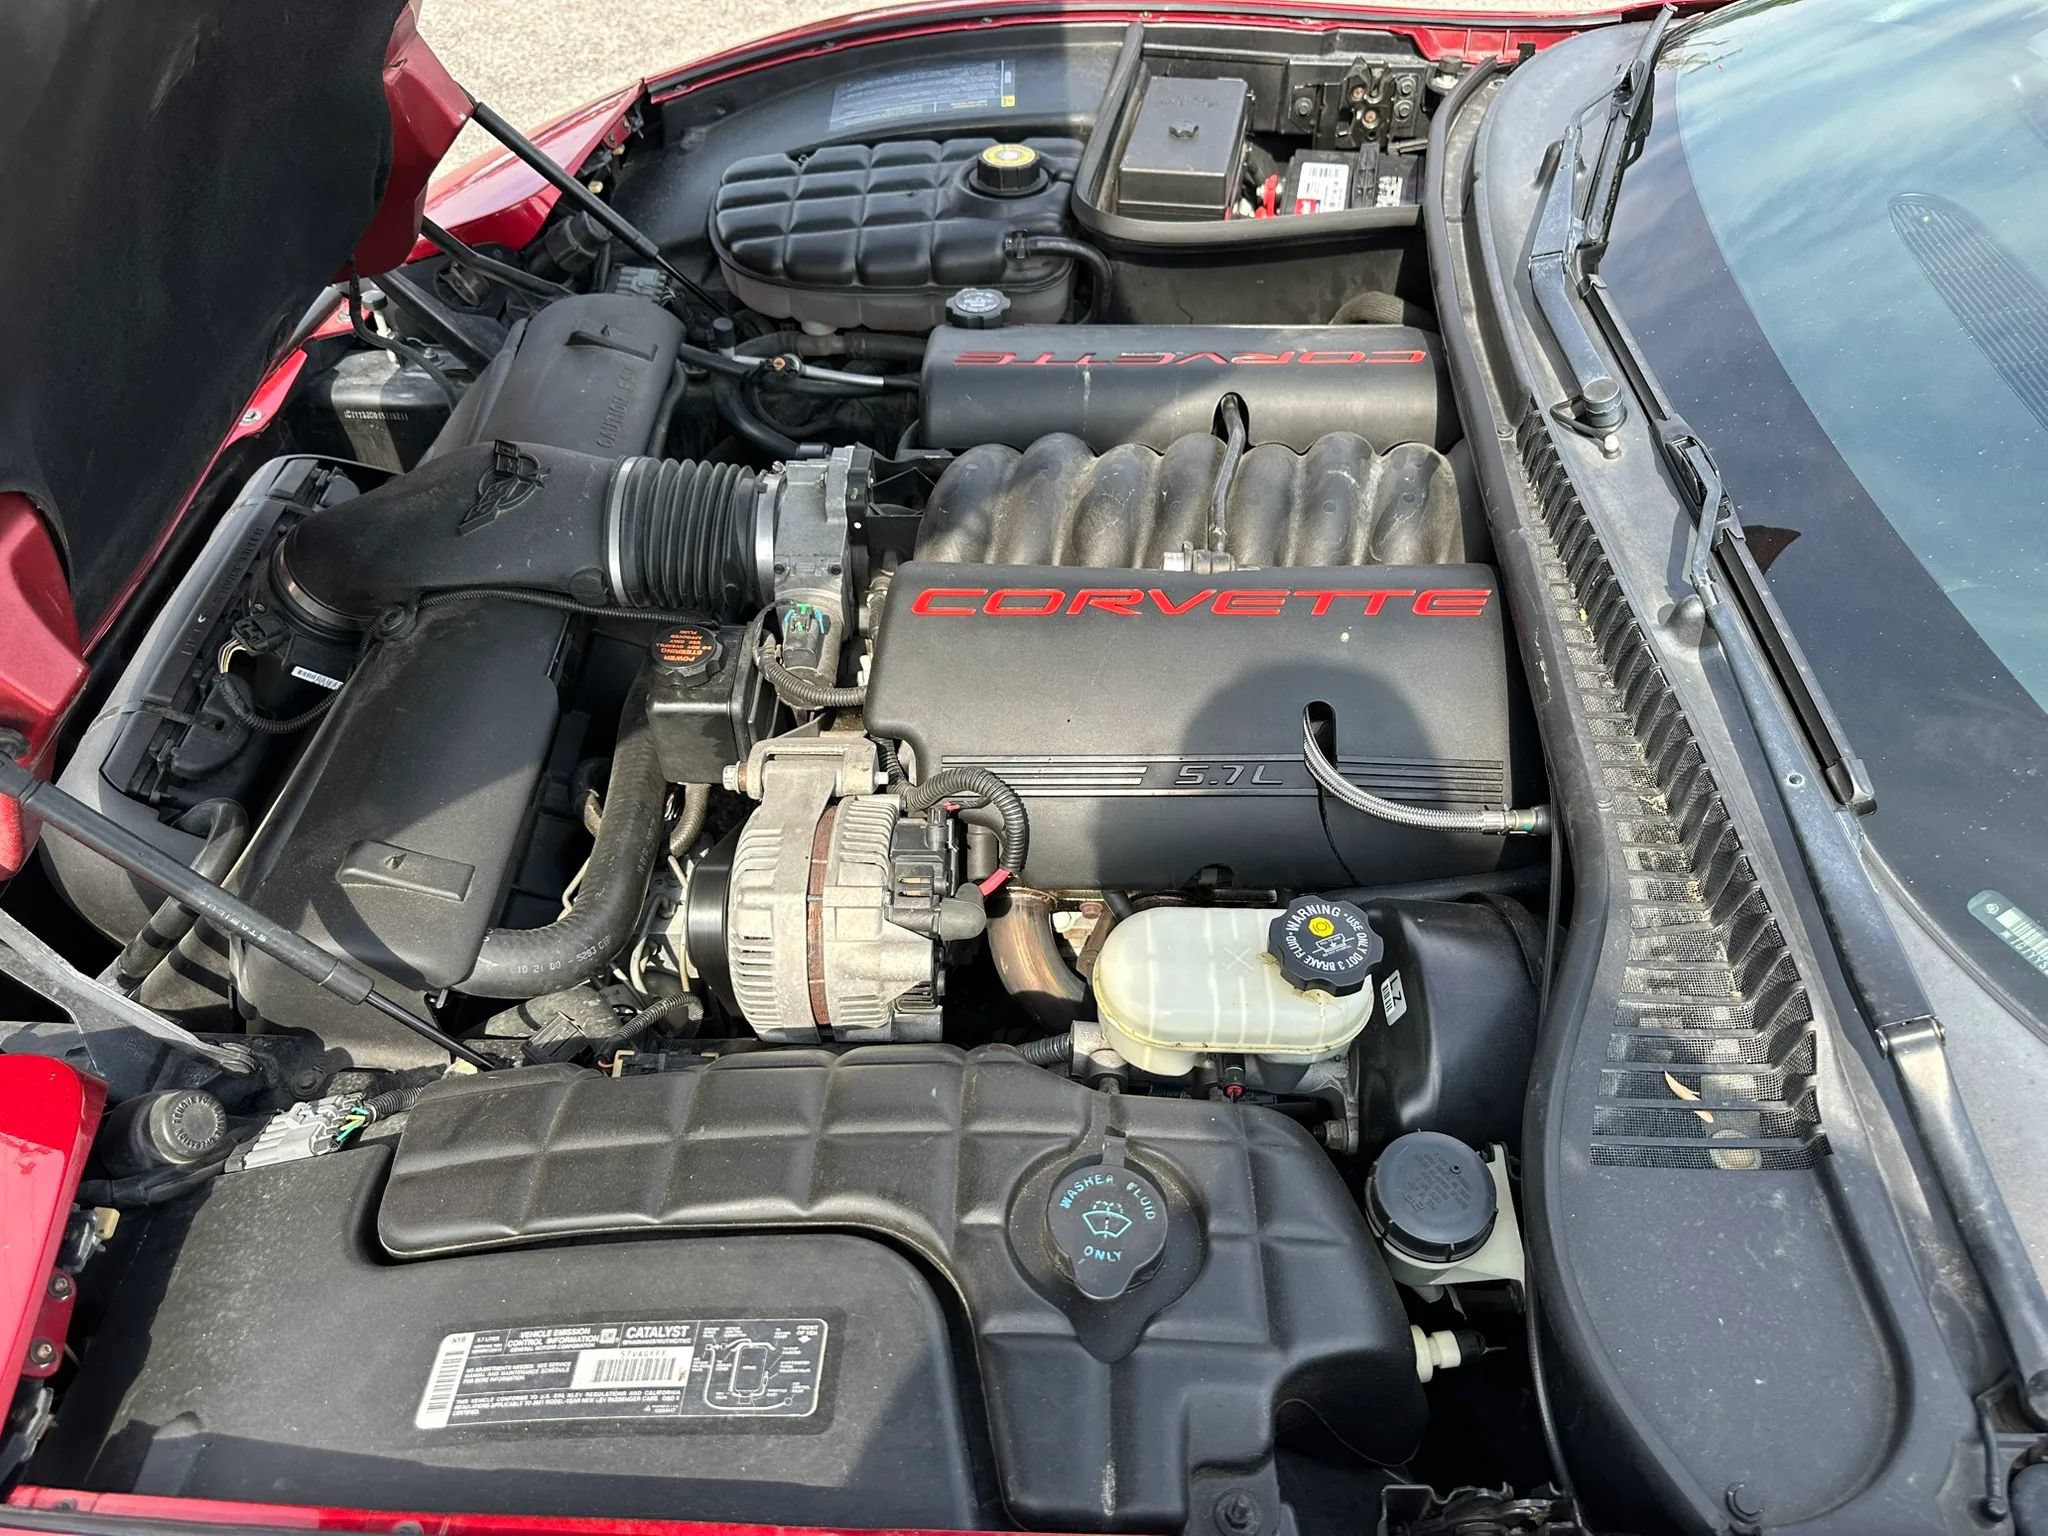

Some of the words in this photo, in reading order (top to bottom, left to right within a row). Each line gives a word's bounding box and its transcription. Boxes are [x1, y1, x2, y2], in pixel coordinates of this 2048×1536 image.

[953, 350, 1427, 366] CORVETTE
[911, 587, 1493, 617] CORVETTE
[660, 648, 703, 656] STEERING
[1173, 764, 1284, 786] 5.7L
[1285, 904, 1341, 932] WARNING
[1346, 915, 1364, 932] USE
[1285, 935, 1306, 959] FLUID
[1356, 932, 1369, 955] ONLY
[1303, 954, 1337, 971] BRAKE
[1338, 961, 1345, 970] 3
[1347, 952, 1364, 969] DOT
[1059, 1174, 1114, 1208] WASHER
[1126, 1182, 1156, 1220] FLUID
[1084, 1245, 1122, 1262] ONLY
[519, 1329, 553, 1339] VEHICLE
[553, 1327, 591, 1337] EMISSION
[625, 1325, 691, 1339] CATALYST
[507, 1338, 544, 1348] CONTROL
[545, 1334, 600, 1344] INFORMATION
[474, 1364, 512, 1373] ADJUSTMENTS
[500, 1368, 540, 1376] MAINTENANCE
[540, 1366, 570, 1374] SCHEDULE
[470, 1396, 495, 1404] VEHICLE
[496, 1394, 529, 1403] CONFORMS
[490, 1400, 523, 1408] APPLICABLE
[607, 1395, 642, 1403] PASSENGER
